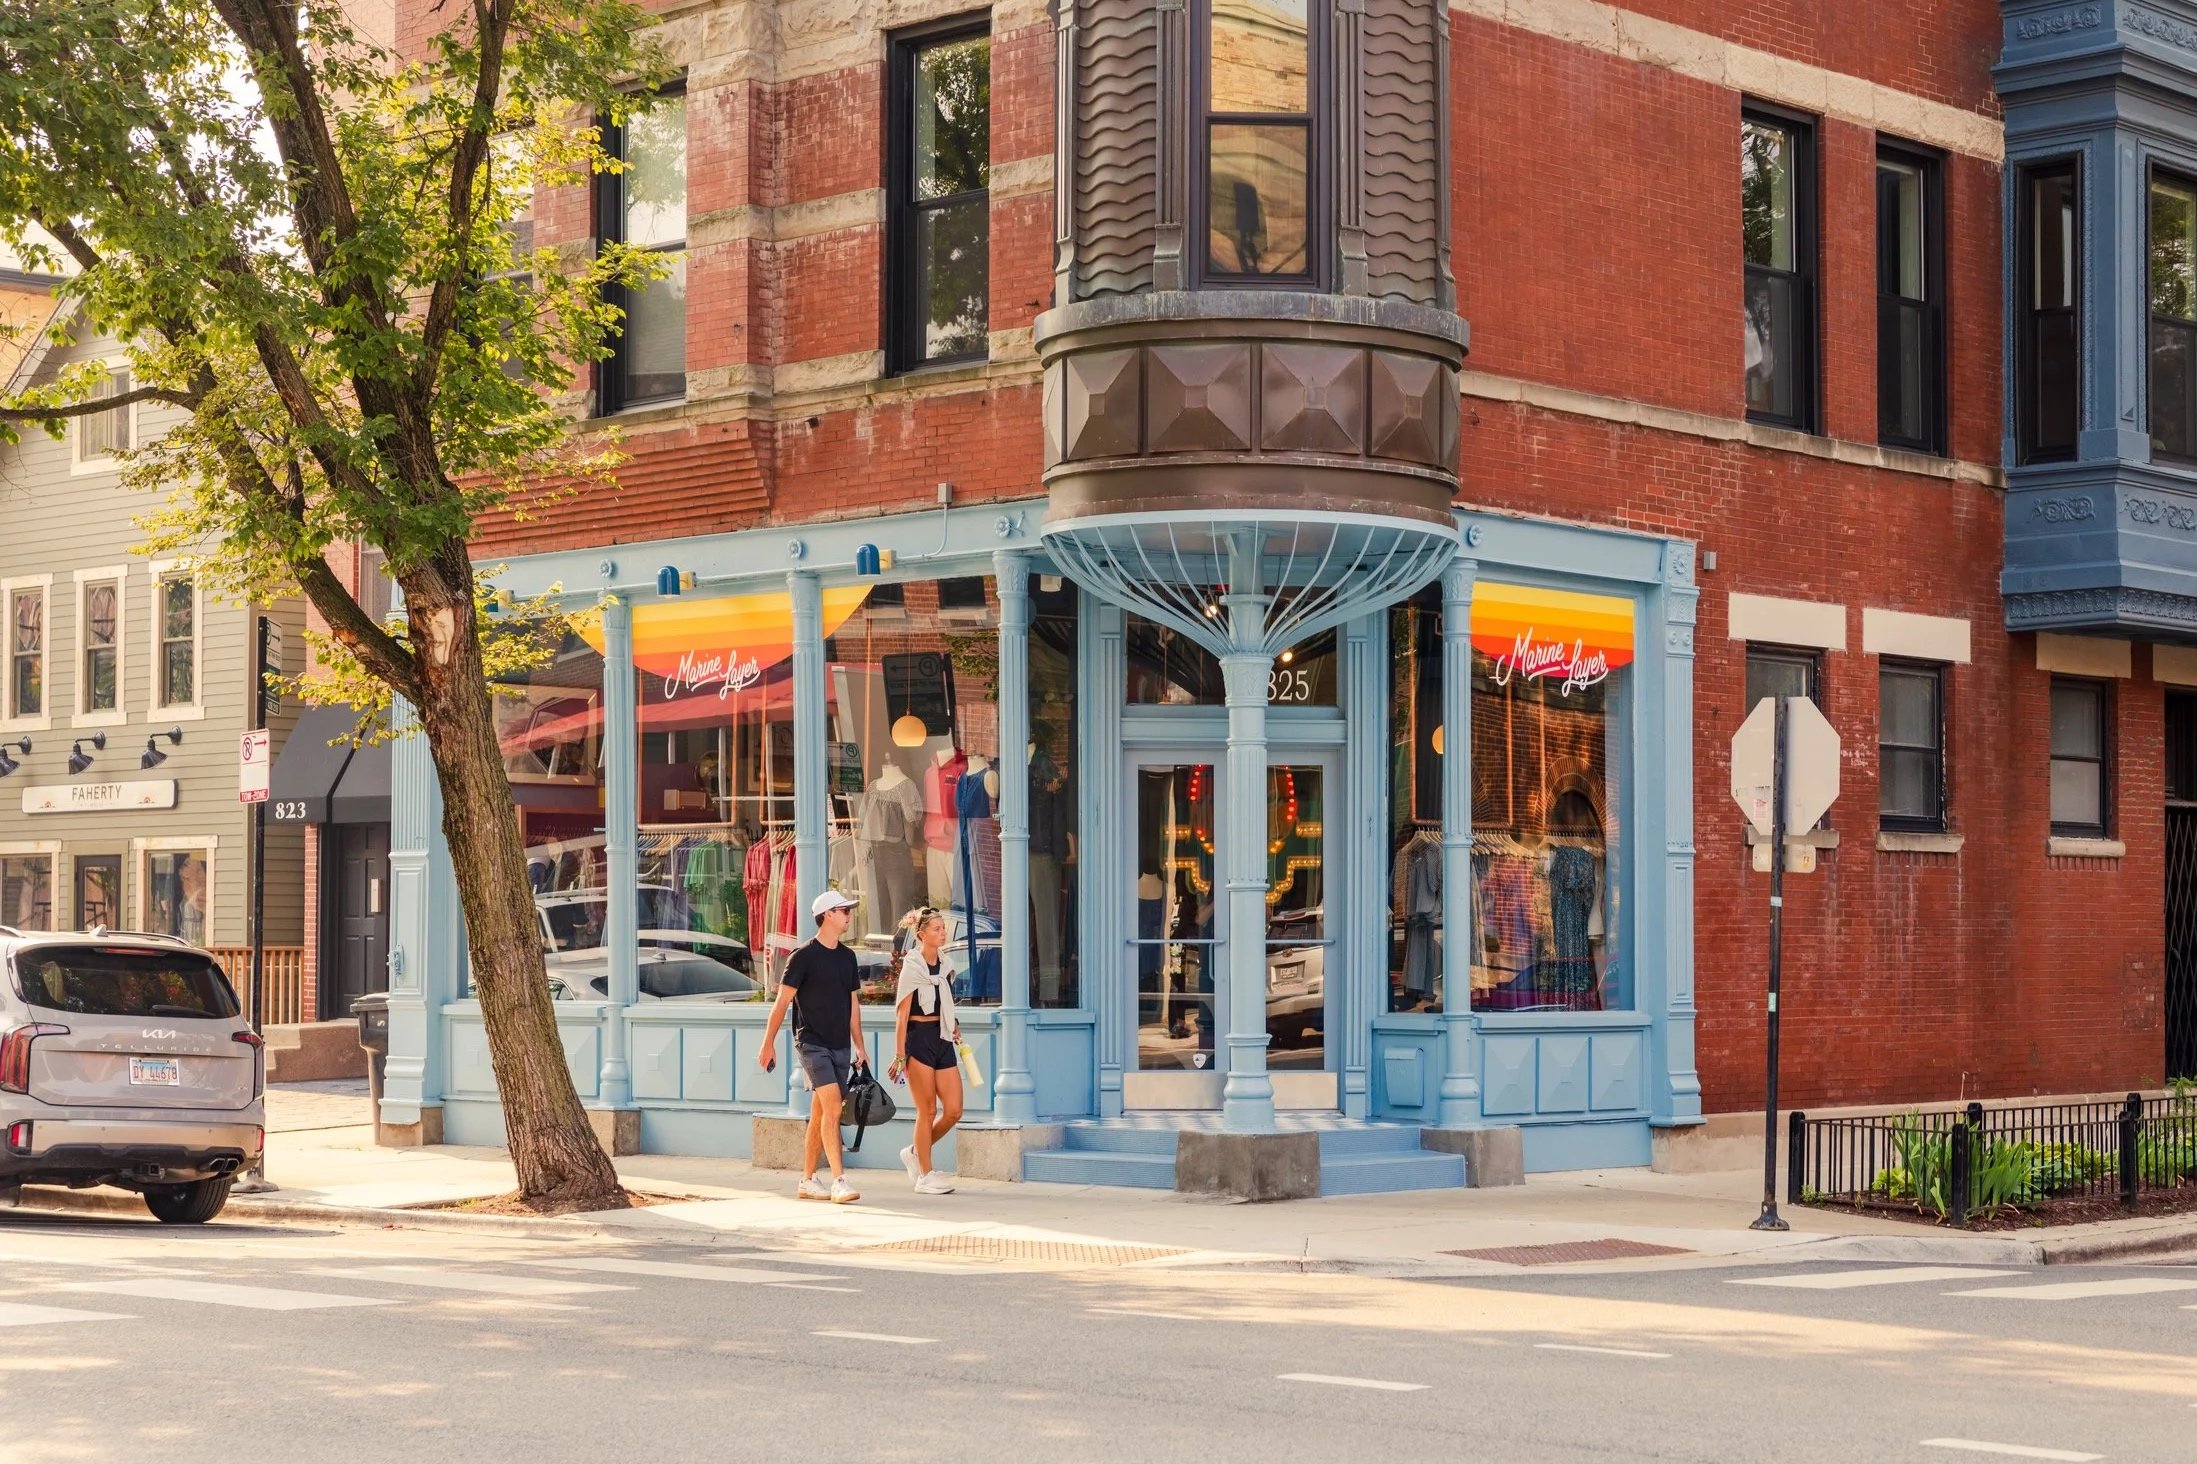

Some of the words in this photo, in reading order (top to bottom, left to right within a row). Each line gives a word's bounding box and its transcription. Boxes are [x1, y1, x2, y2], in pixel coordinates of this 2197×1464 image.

[1496, 626, 1565, 686] Marine
[1562, 638, 1608, 697] Layer
[664, 649, 721, 699] Marine
[719, 650, 760, 700] Layer
[72, 785, 122, 801] FAHERTY
[275, 801, 306, 820] 823
[142, 1028, 176, 1039] KIA
[100, 1043, 211, 1052] TELLURIDE
[133, 1065, 144, 1079] DY
